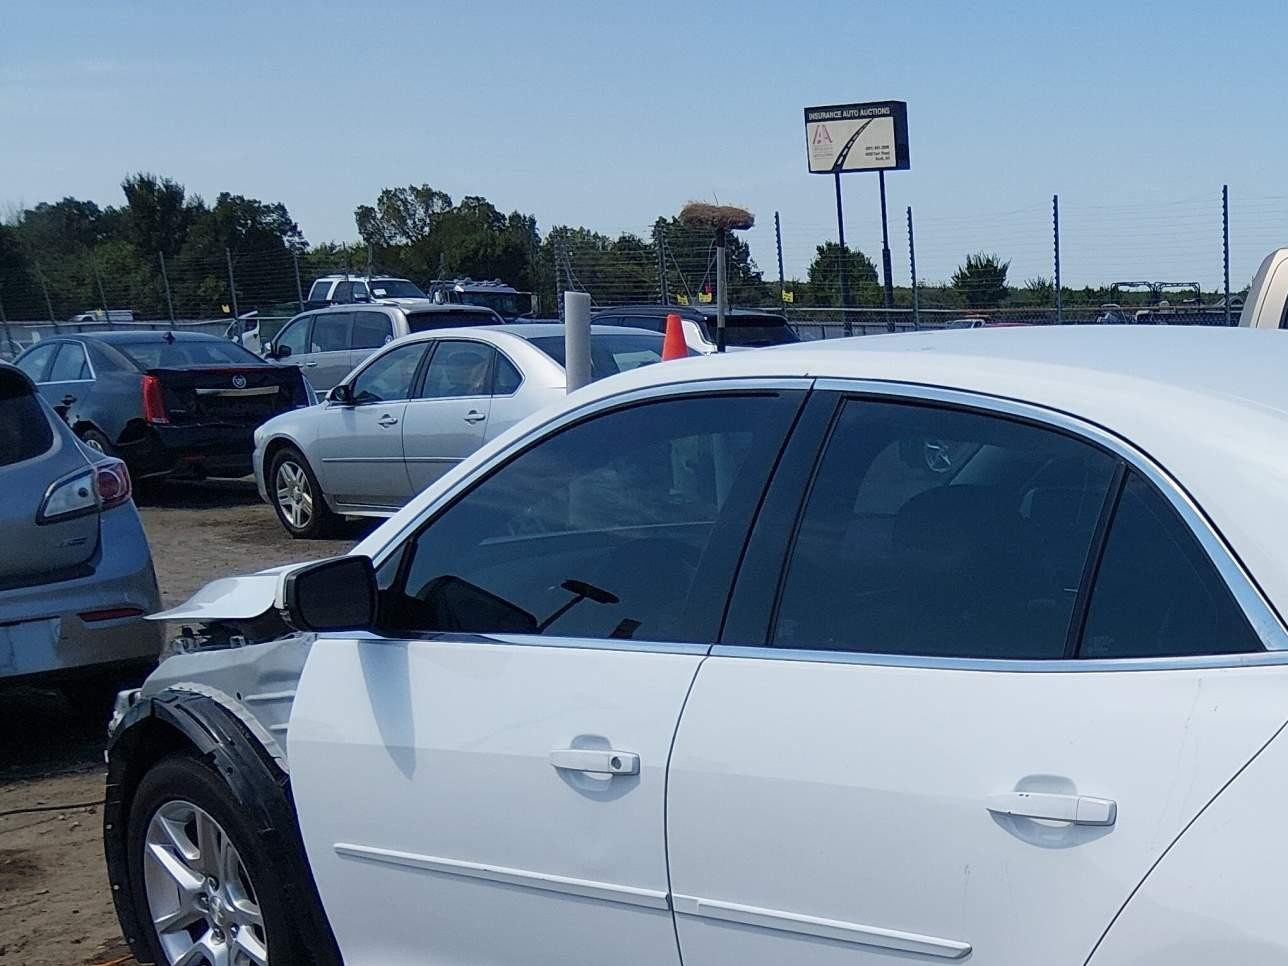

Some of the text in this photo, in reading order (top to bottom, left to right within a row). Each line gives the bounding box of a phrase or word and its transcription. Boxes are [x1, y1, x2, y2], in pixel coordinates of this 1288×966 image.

[808, 107, 890, 120] INSURANCE AUTO AUCTIONS
